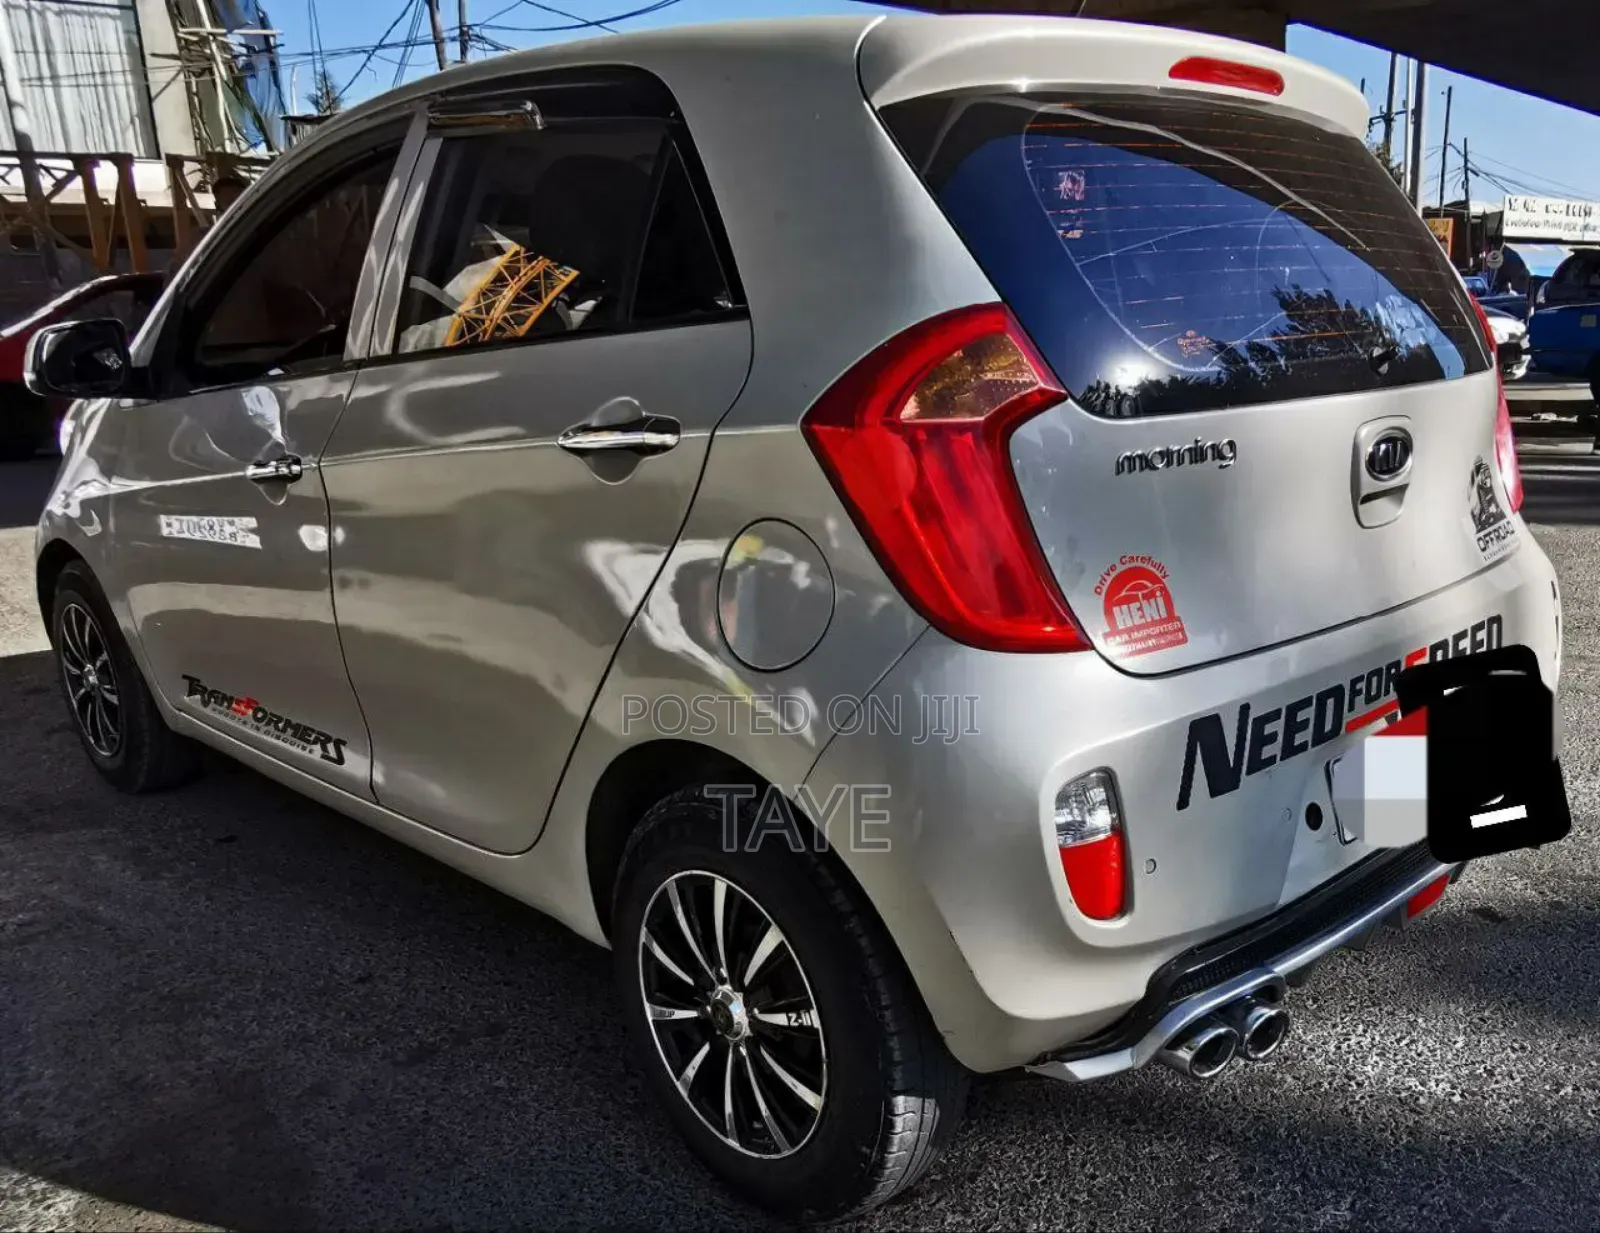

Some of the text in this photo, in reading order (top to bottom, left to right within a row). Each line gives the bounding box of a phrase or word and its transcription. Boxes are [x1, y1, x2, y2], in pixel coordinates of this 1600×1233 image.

[1114, 437, 1237, 476] morning
[1094, 554, 1170, 596] Drive Carefully
[1176, 682, 1346, 810] NEED
[1348, 659, 1402, 713] FOR
